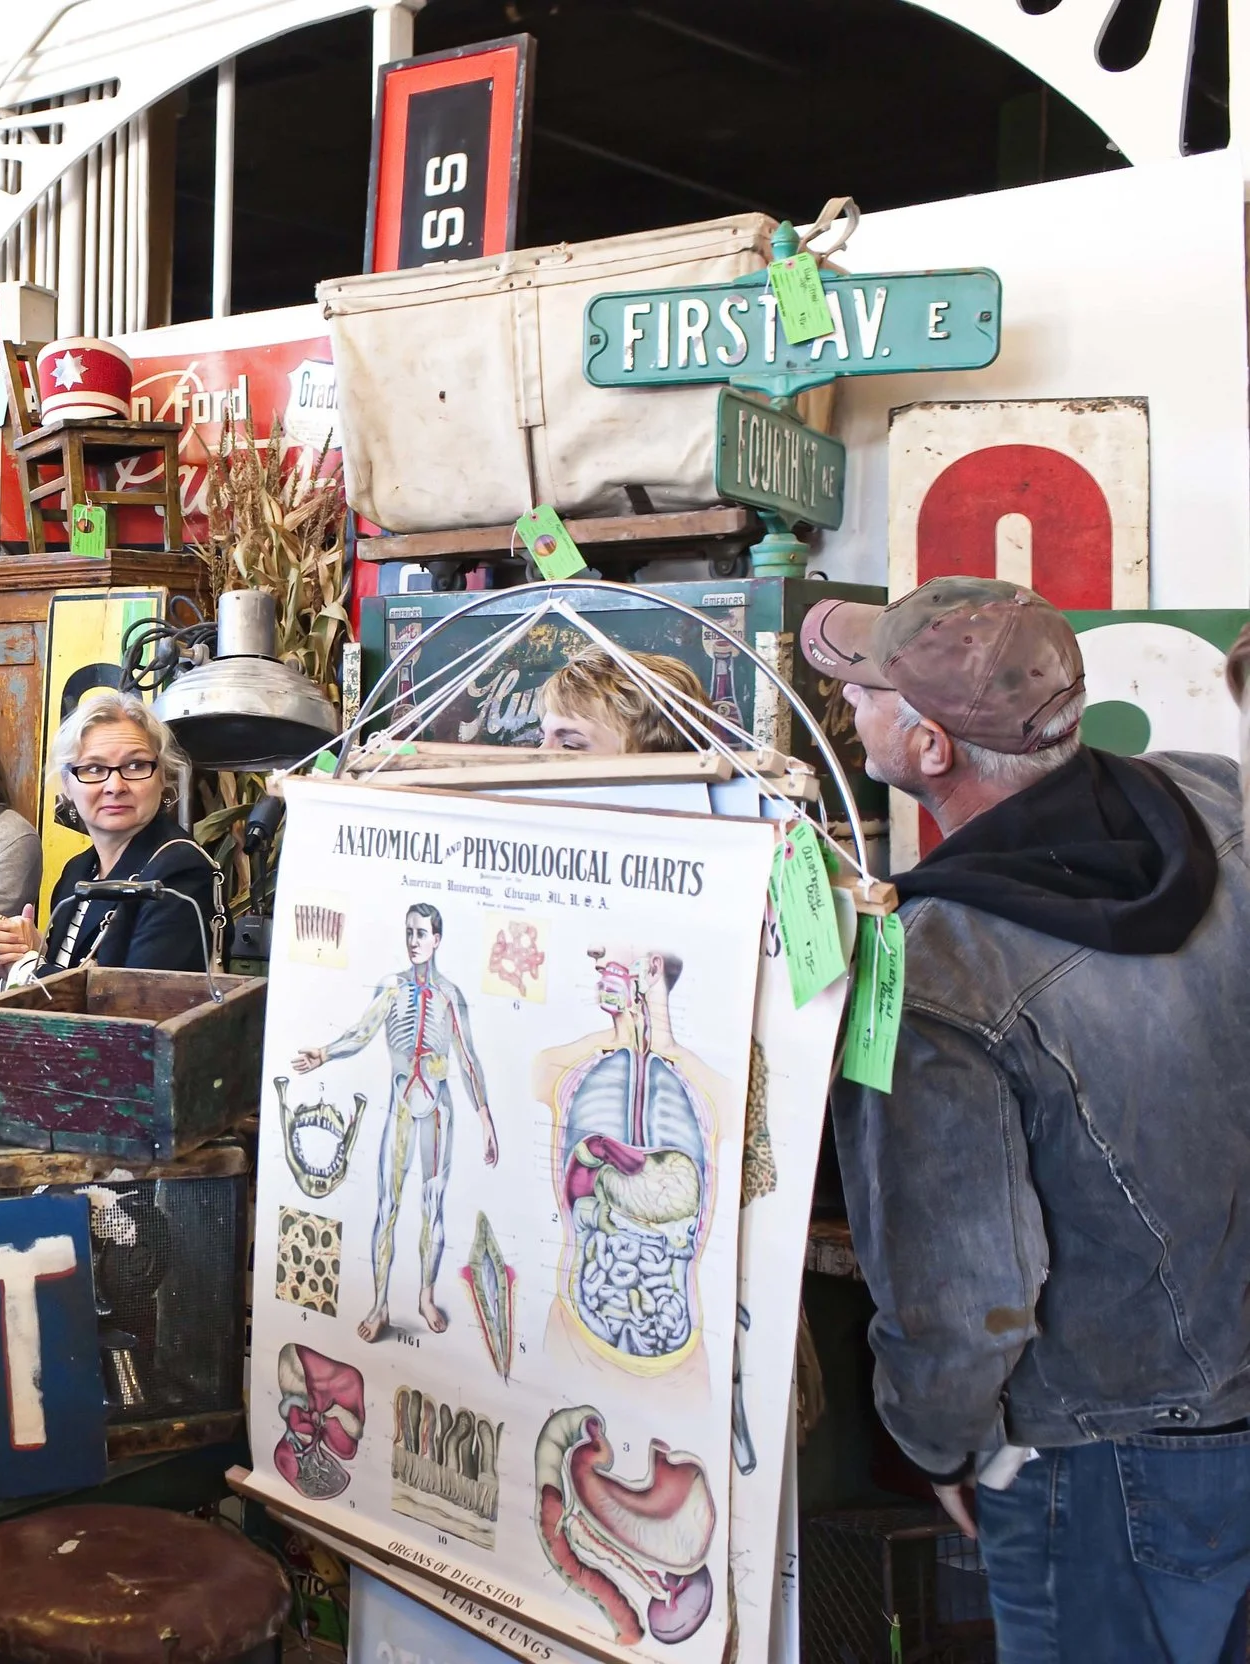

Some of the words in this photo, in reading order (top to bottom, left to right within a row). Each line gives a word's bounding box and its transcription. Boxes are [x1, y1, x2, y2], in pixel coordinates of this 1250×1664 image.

[421, 152, 468, 268] SS
[622, 292, 779, 373] FIRST
[927, 301, 951, 341] E
[173, 374, 249, 425] Ford
[298, 370, 339, 411] Grad
[736, 409, 801, 502] FOURTH
[803, 438, 819, 508] ST
[821, 464, 836, 499] NE
[331, 824, 444, 865] ANATOMICAL
[444, 840, 463, 861] AND
[462, 836, 612, 886] PHYSIOLOGICAL
[620, 853, 705, 897] CHARTS
[513, 1001, 521, 1011] 6
[318, 1081, 325, 1093] 5
[551, 1213, 558, 1223] 2
[301, 1311, 308, 1322] 4
[519, 1342, 526, 1354] 8
[623, 1442, 630, 1453] 3
[437, 1534, 448, 1546] 10
[387, 1541, 434, 1568] ORGANS
[433, 1560, 451, 1574] OF
[450, 1569, 525, 1609] DIGESTION
[441, 1588, 486, 1621] VEINS
[486, 1616, 497, 1629] &
[499, 1622, 554, 1660] LUNGS
